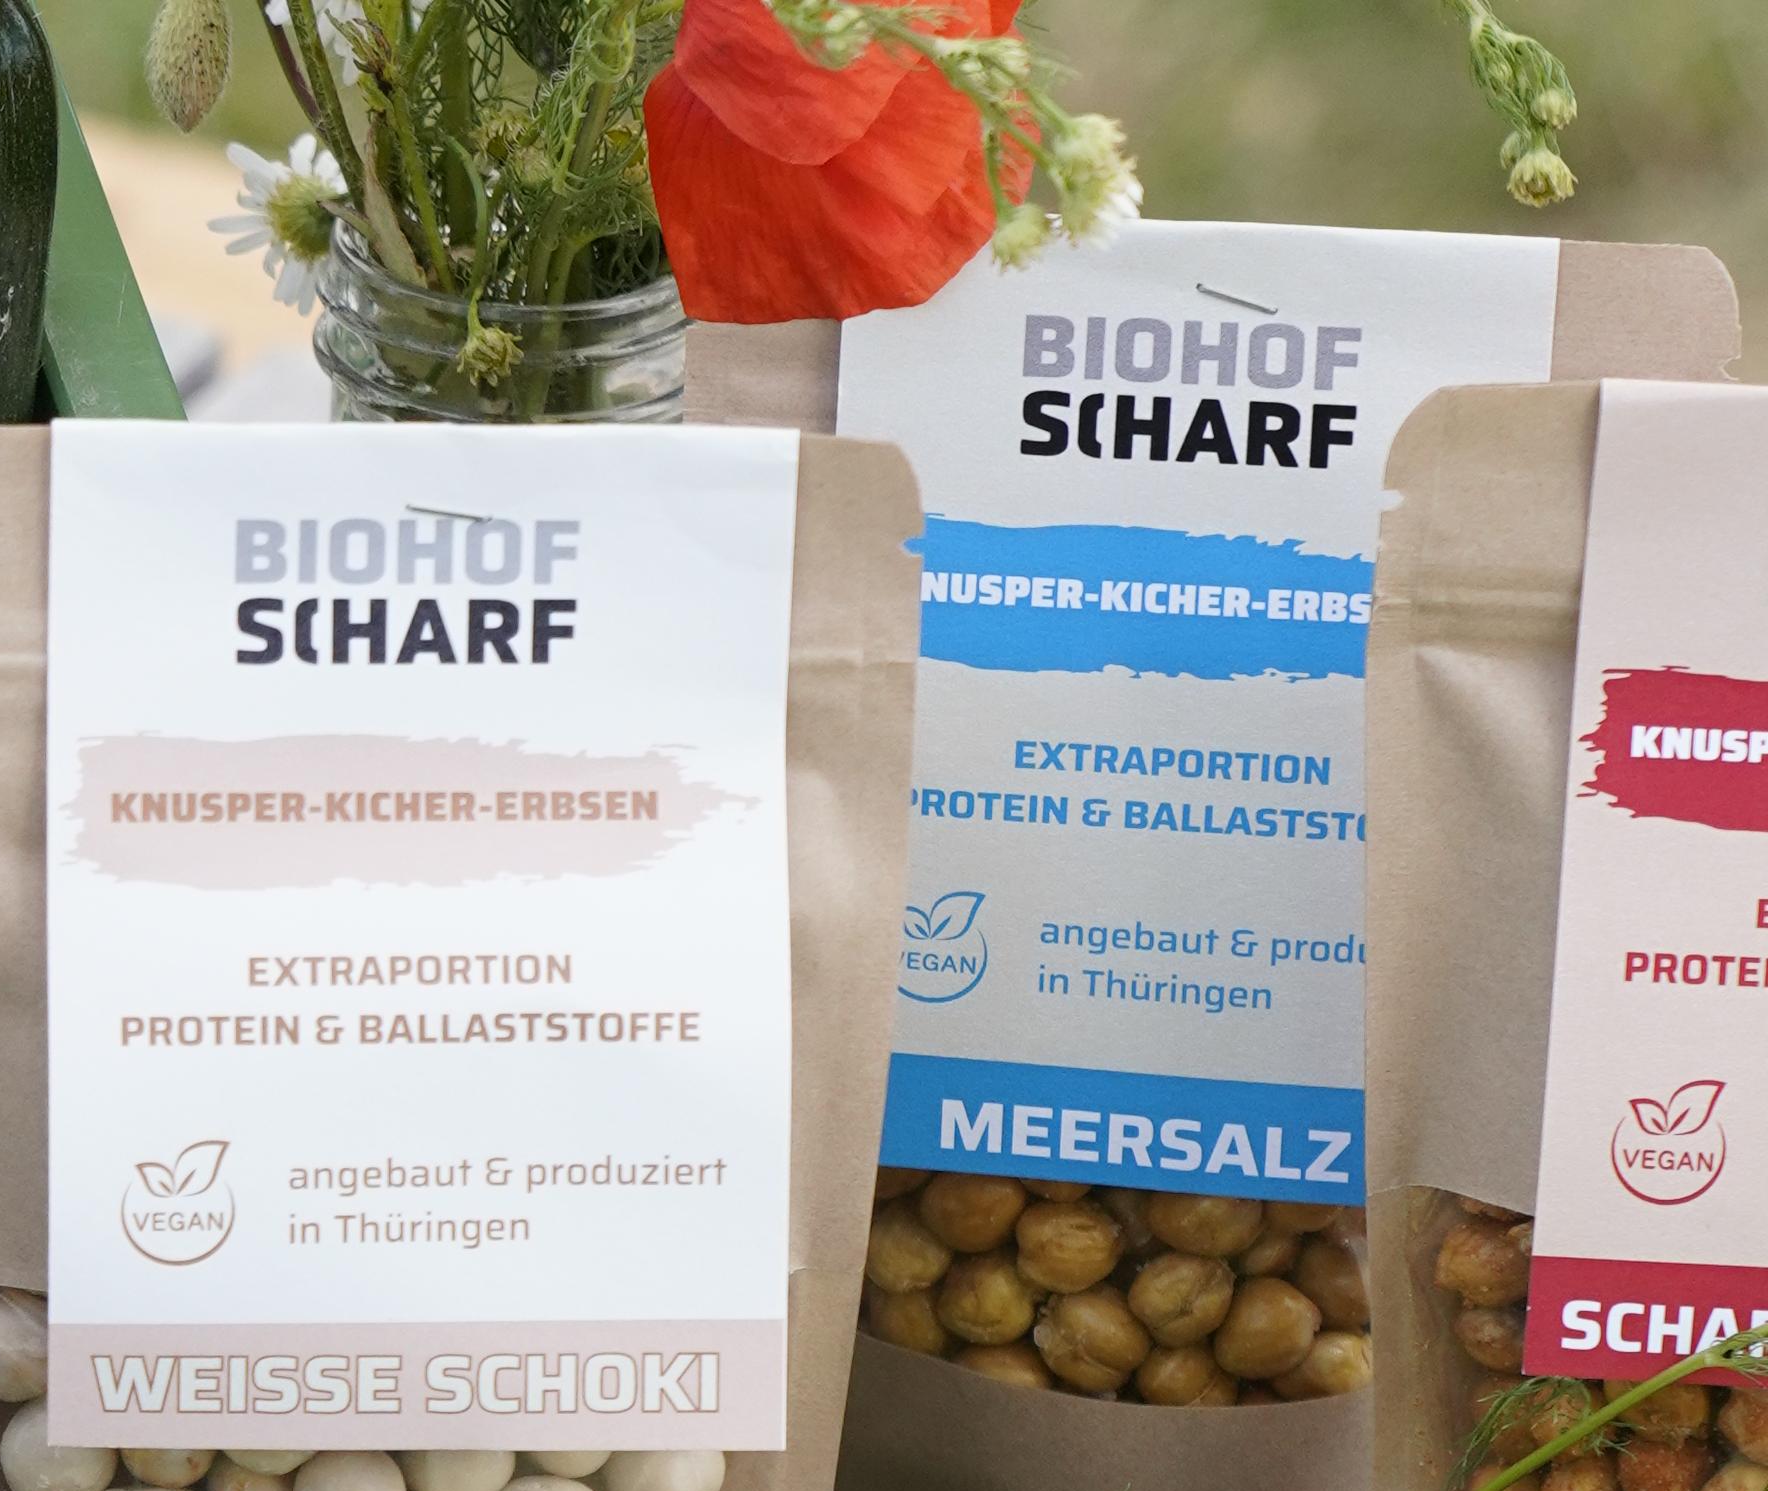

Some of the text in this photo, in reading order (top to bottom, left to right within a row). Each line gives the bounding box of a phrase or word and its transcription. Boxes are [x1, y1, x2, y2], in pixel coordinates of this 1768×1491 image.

[1021, 313, 1363, 391] BIOHOF
[1020, 390, 1357, 469] SCHARF
[235, 518, 580, 585] BIOHOF
[235, 597, 578, 665] SCHARF
[1014, 740, 1331, 785] EXTRAPORTION
[110, 789, 659, 825] KNUSPER-KICHER-ERBSEN
[1082, 799, 1111, 827] &
[1039, 921, 1220, 955] angebaut
[1230, 930, 1259, 958] &
[248, 953, 573, 988] EXTRAPORTION
[1038, 965, 1272, 1013] in Thüringen
[120, 1011, 701, 1047] PROTEIN & BALLASTSTOFFE
[939, 1098, 1352, 1184] MEERSALZ
[1623, 1148, 1716, 1173] VEGAN
[289, 1154, 728, 1197] angebaut & produziert
[133, 1211, 225, 1234] VEGAN
[289, 1211, 530, 1249] in Thüringen
[1560, 1299, 1768, 1358] SCHA
[91, 1351, 721, 1415] WEISSE SCHOKI
